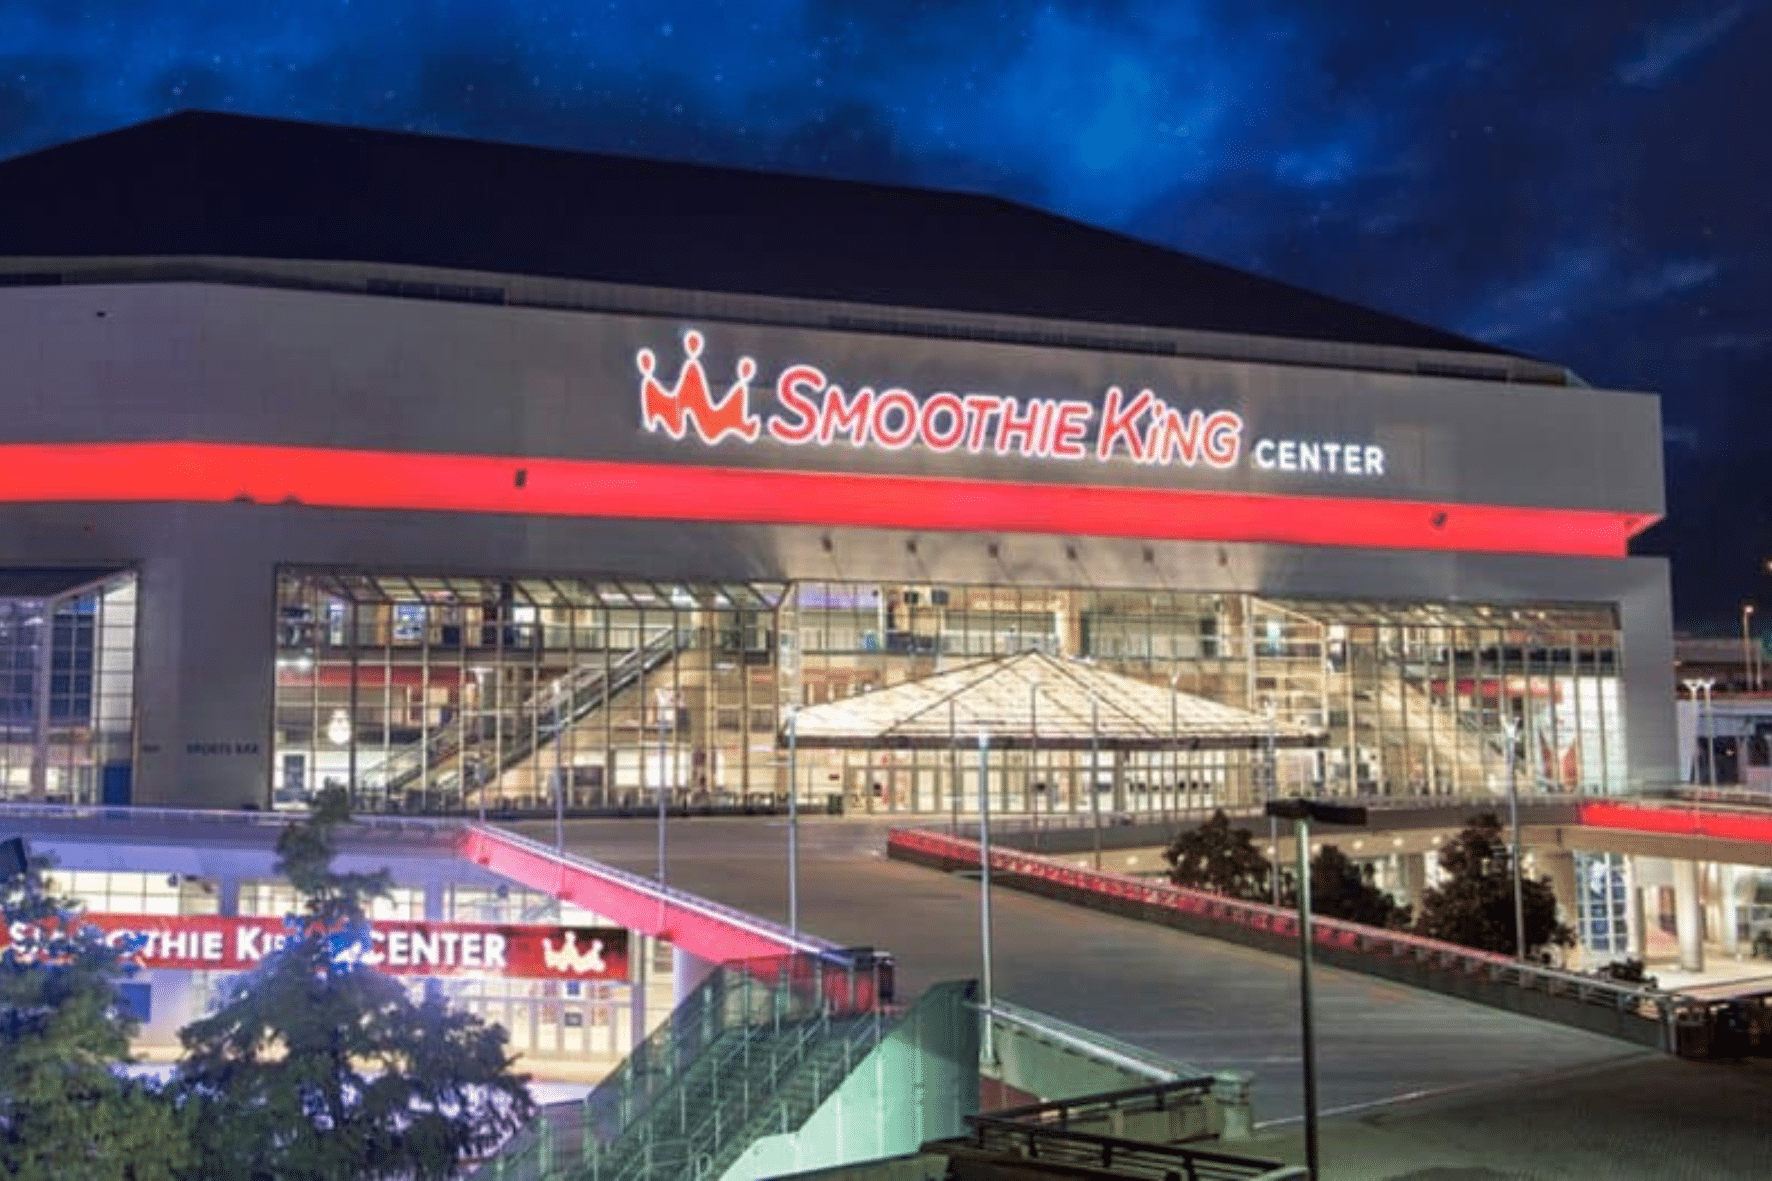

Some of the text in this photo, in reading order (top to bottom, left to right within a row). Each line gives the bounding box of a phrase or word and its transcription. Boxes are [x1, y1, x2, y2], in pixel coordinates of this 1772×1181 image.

[768, 364, 1093, 460] SMOOTHIE
[1254, 438, 1385, 476] CENTER
[9, 921, 224, 960] STHIE
[361, 929, 506, 968] CENTER
